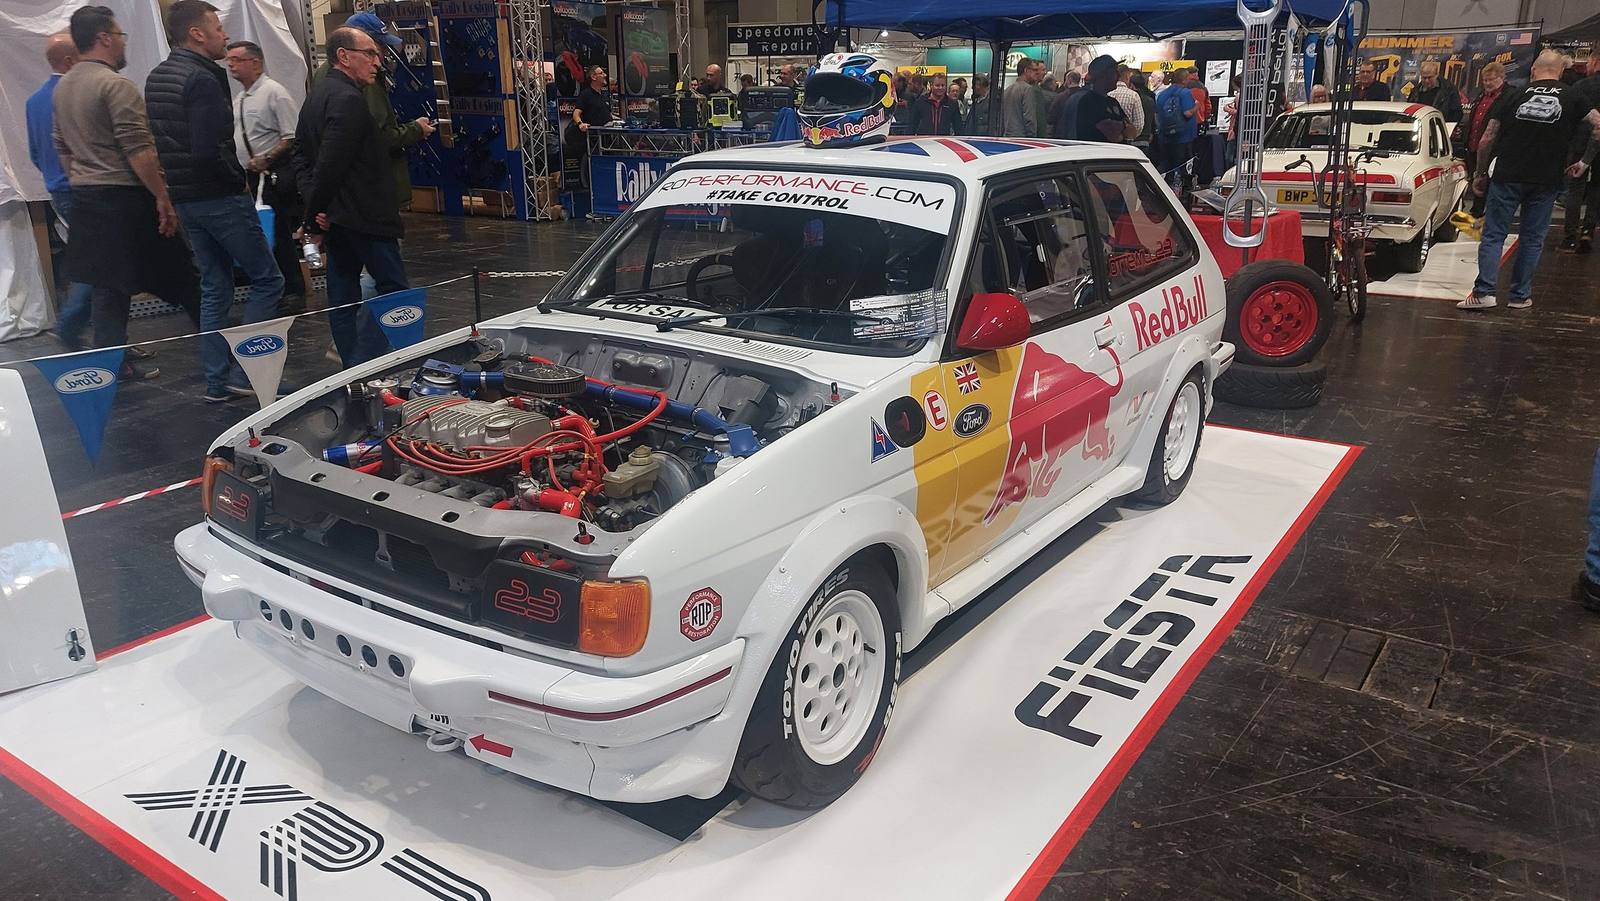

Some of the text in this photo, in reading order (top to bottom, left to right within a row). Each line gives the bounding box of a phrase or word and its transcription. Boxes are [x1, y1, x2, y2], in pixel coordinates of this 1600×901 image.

[737, 26, 826, 39] Speedome
[1358, 36, 1454, 48] HUMMER
[706, 190, 849, 209] #TAKE CONTROL
[649, 305, 712, 322] SAL
[1128, 274, 1207, 351] Red Bull
[926, 394, 946, 426] E
[962, 409, 984, 432] Ford
[494, 579, 561, 623] 23
[797, 567, 850, 636] TIRES
[1014, 555, 1253, 748] FIESTA
[782, 639, 801, 740] TOYO
